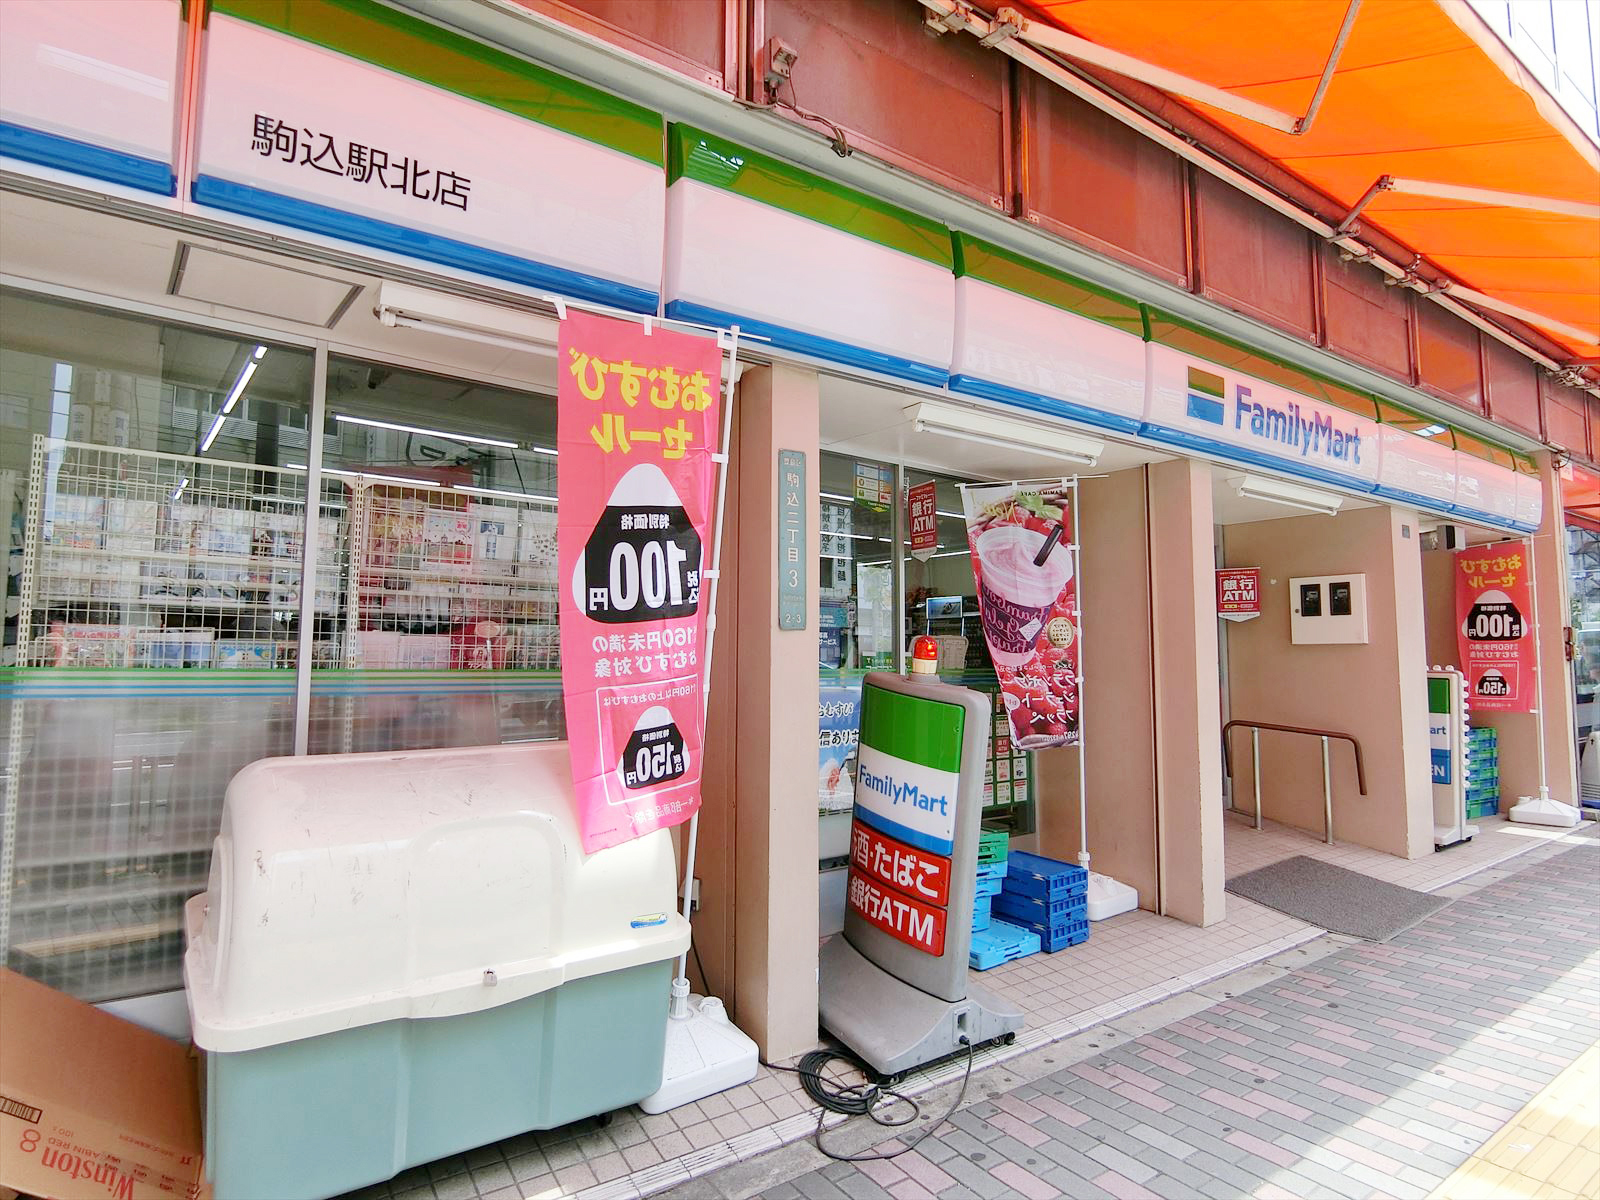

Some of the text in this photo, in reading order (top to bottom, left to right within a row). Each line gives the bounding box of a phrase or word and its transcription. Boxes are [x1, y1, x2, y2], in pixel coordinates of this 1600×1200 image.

[250, 113, 471, 212] 駒込駅北店
[1235, 384, 1361, 465] FamilyMart
[912, 499, 933, 517] 銀行
[913, 515, 934, 532] ATM
[1223, 579, 1255, 591] 銀行
[1223, 590, 1255, 601] ATM
[859, 763, 948, 817] FamilyMart
[852, 829, 940, 899] 酒・たばこ
[850, 875, 935, 946] 銀行ATM
[19, 1128, 41, 1153] 8
[41, 1147, 135, 1200] Winston
